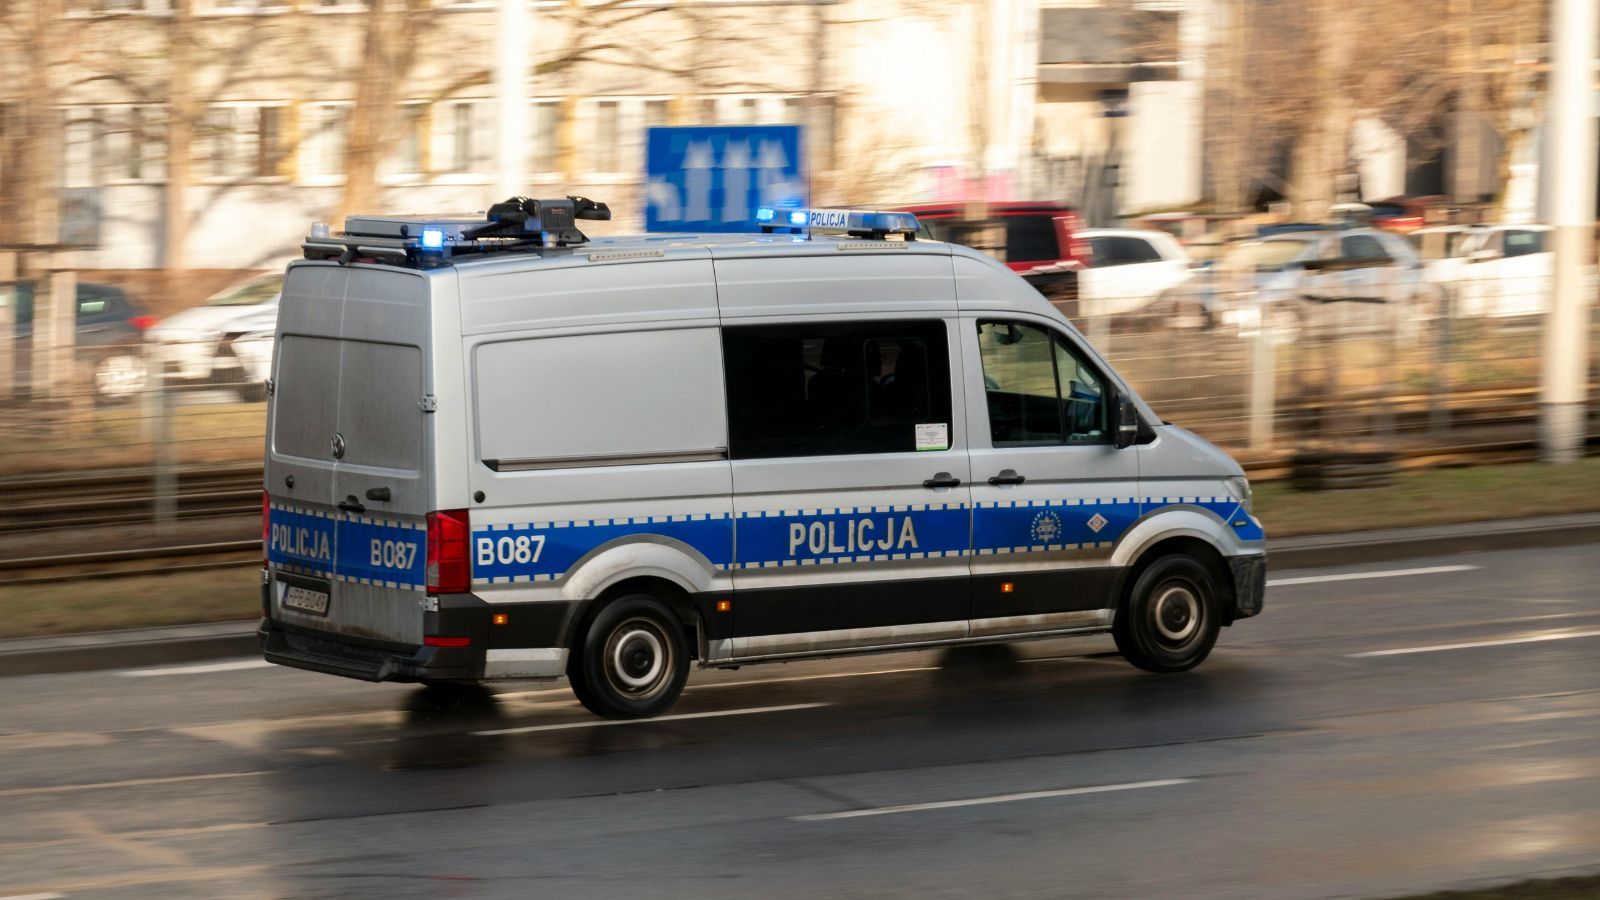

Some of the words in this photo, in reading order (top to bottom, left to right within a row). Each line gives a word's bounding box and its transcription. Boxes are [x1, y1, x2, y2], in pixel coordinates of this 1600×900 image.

[810, 212, 845, 226] POLICJA
[271, 523, 330, 560] POLICJA
[370, 538, 417, 570] B087
[477, 535, 546, 566] B087
[789, 516, 918, 556] POLICJA
